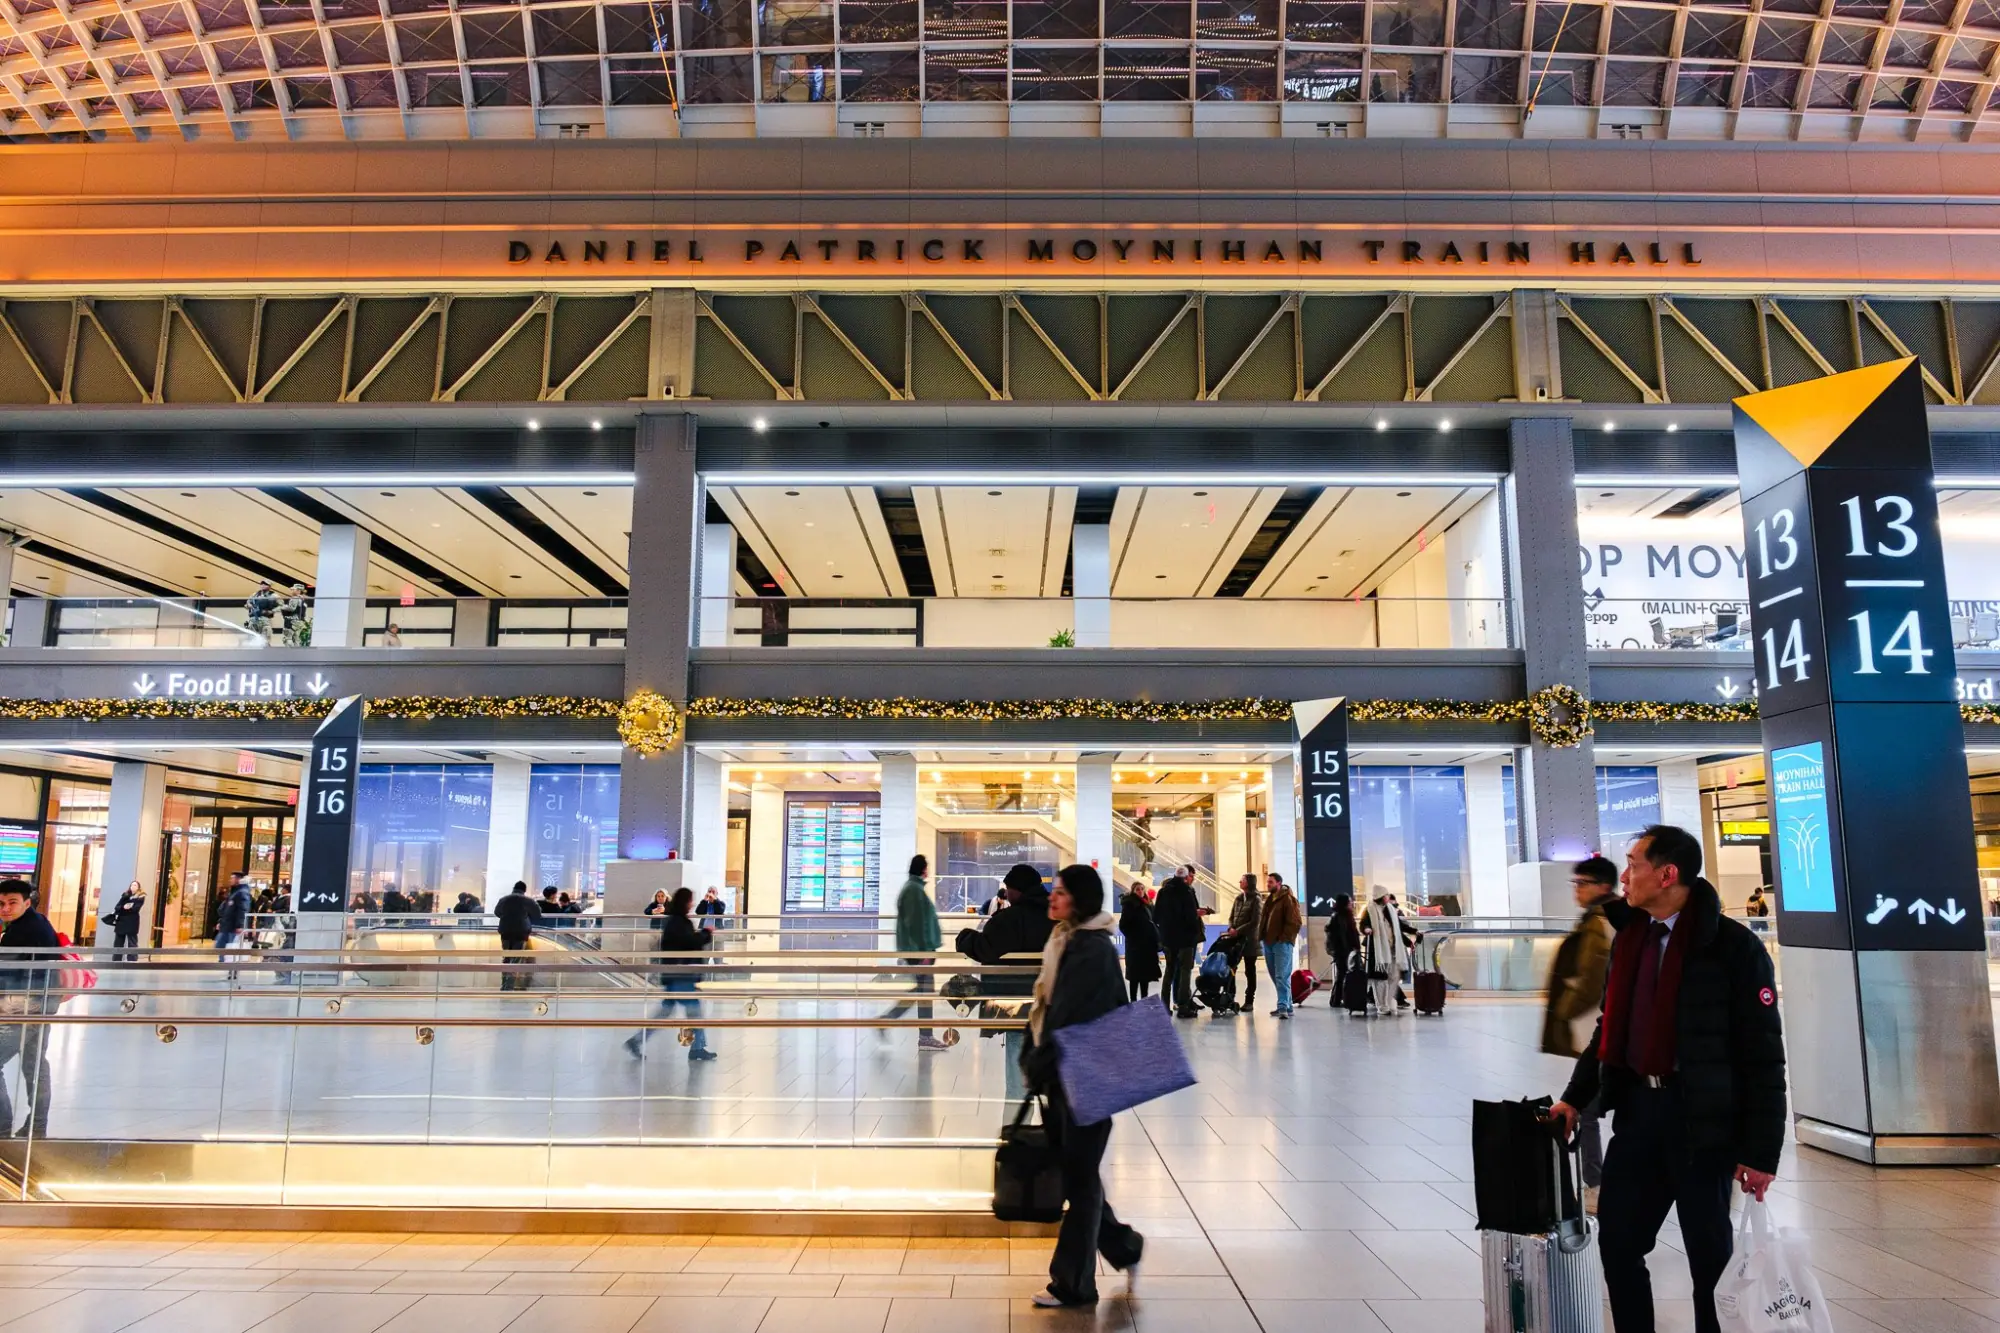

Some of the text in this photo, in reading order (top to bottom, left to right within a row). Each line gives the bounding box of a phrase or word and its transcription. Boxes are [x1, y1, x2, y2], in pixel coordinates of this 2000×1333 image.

[508, 239, 1703, 265] DANIEL PATRICK MOYNIHAN TRAIN HALL
[1839, 495, 1919, 558] 13
[1755, 508, 1798, 580] 13
[1761, 618, 1811, 690] 14
[1847, 610, 1935, 674] 14
[168, 673, 292, 696] Food Hall
[319, 747, 348, 772] 15
[1311, 750, 1340, 775] 15
[1776, 765, 1823, 783] MOYNIHAN
[1777, 777, 1825, 795] TRAIN HALL
[316, 789, 345, 815] 16
[1313, 792, 1343, 818] 16
